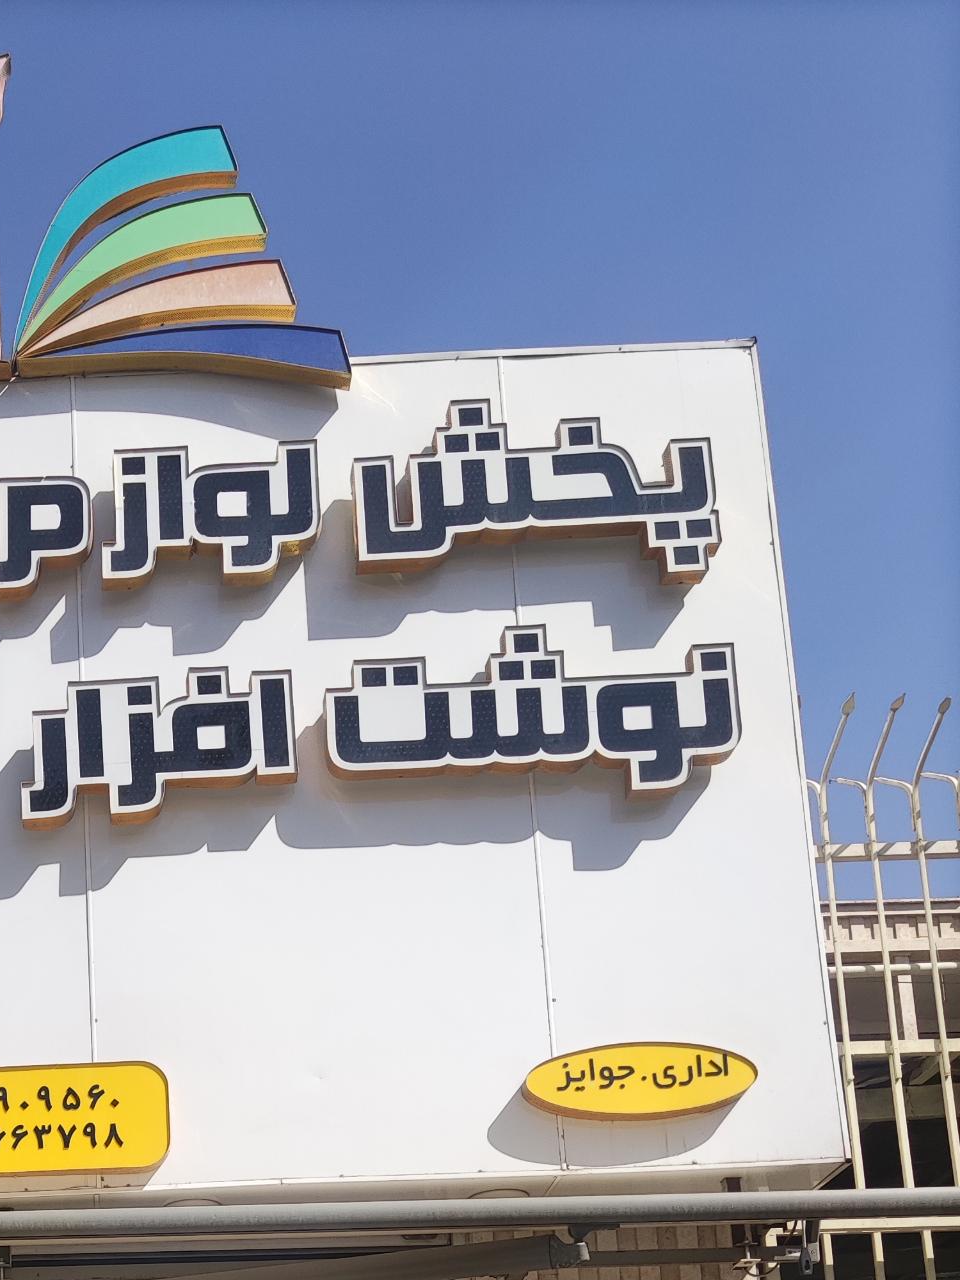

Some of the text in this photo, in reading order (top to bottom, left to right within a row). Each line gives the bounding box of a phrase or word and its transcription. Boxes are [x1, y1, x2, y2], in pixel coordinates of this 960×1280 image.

[359, 405, 712, 566] پخش
[28, 634, 733, 812] نوشت افزار
